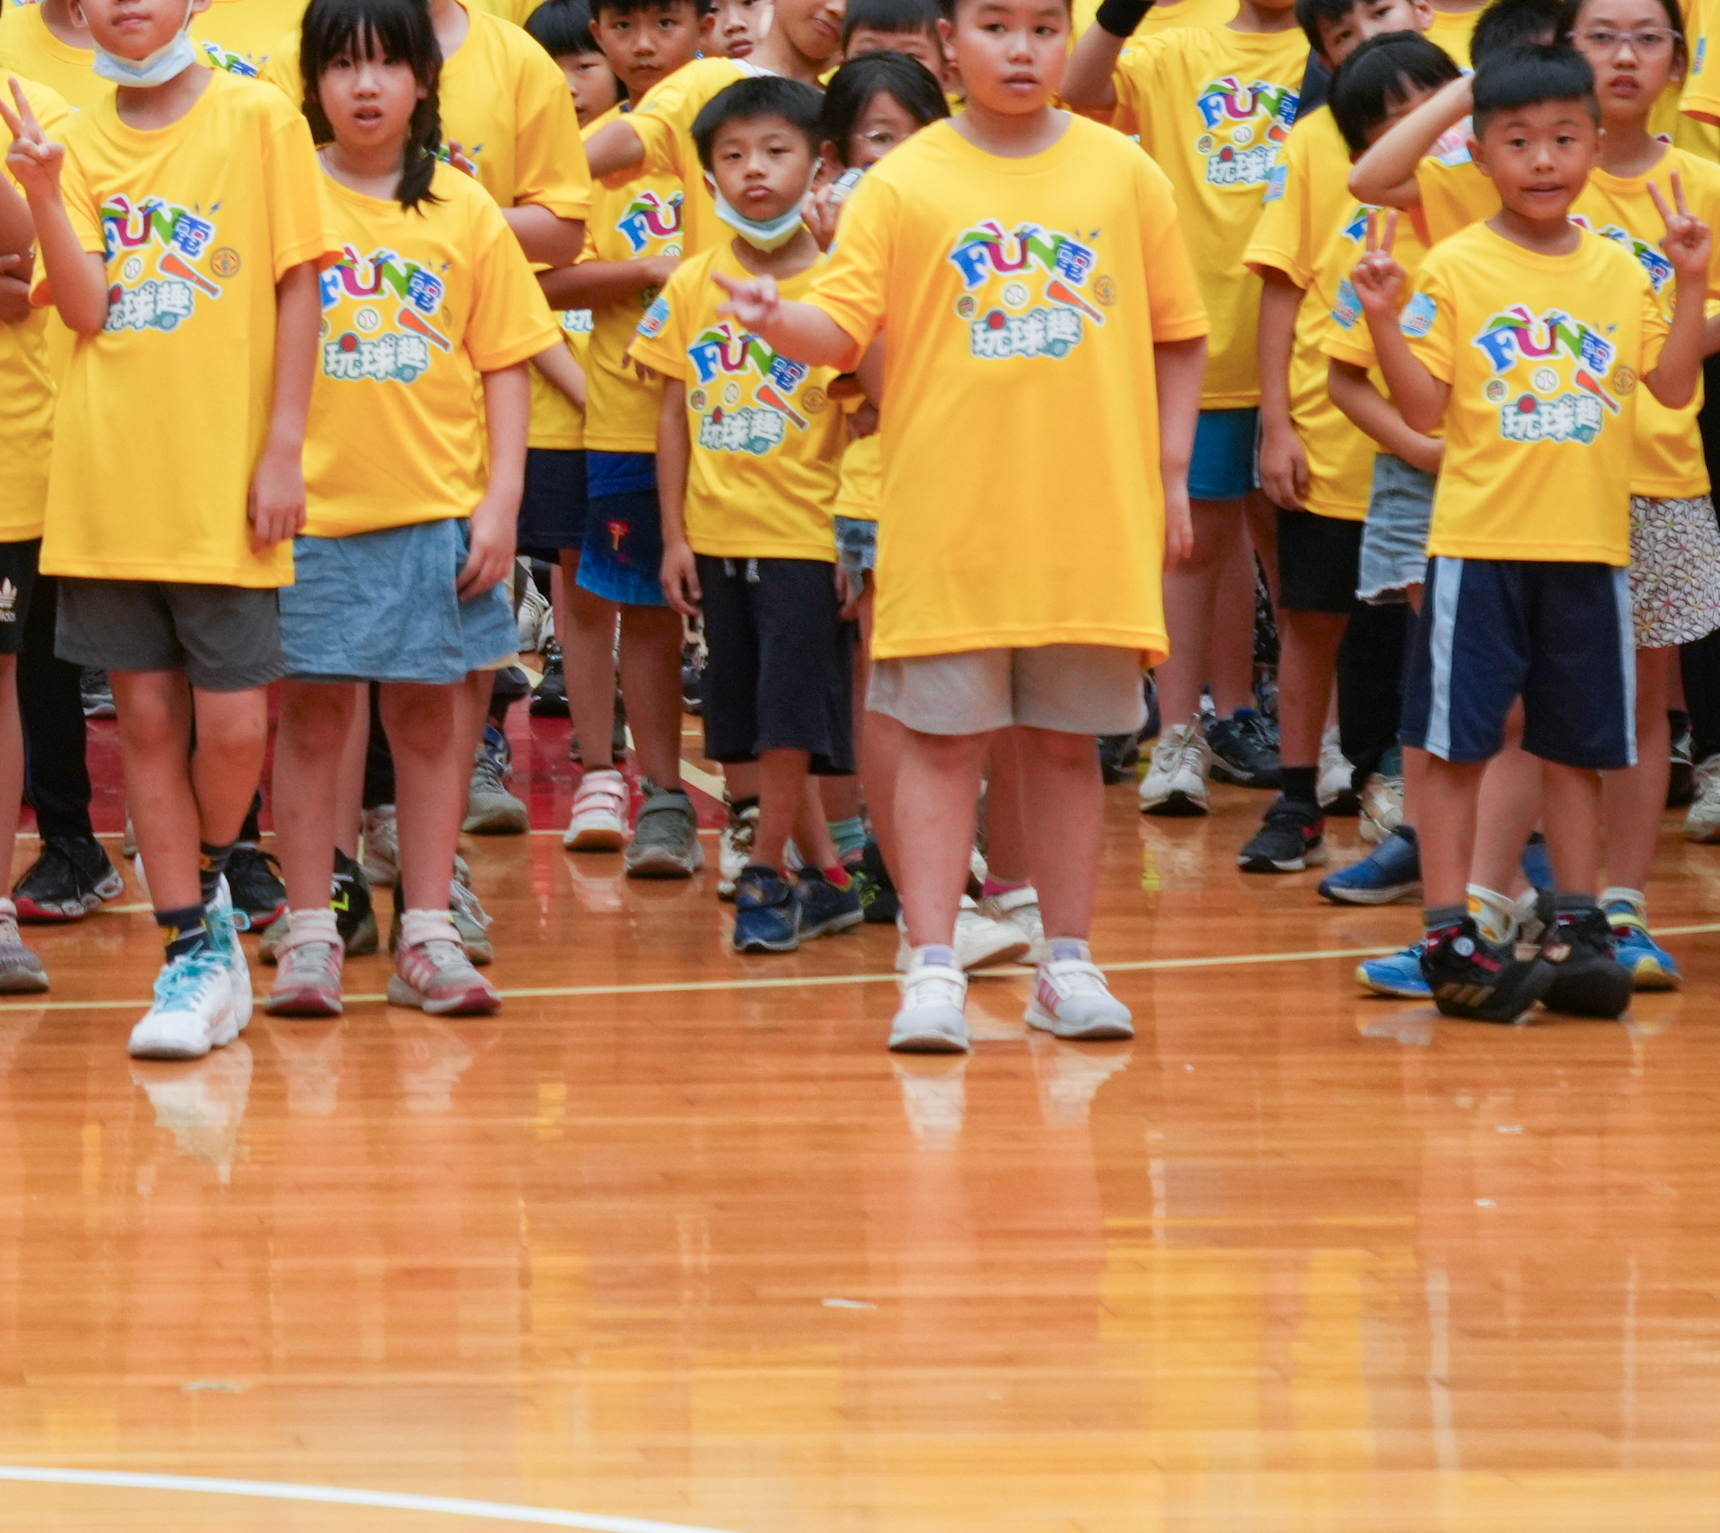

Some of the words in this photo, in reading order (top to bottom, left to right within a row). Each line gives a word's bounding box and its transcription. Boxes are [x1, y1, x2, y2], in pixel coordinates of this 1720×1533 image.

[948, 218, 1099, 289] FUN電
[323, 332, 429, 384] 玩球趣
[970, 305, 1083, 359] 玩球趣
[1475, 302, 1616, 375] FUN電
[1500, 392, 1604, 445] 玩球趣
